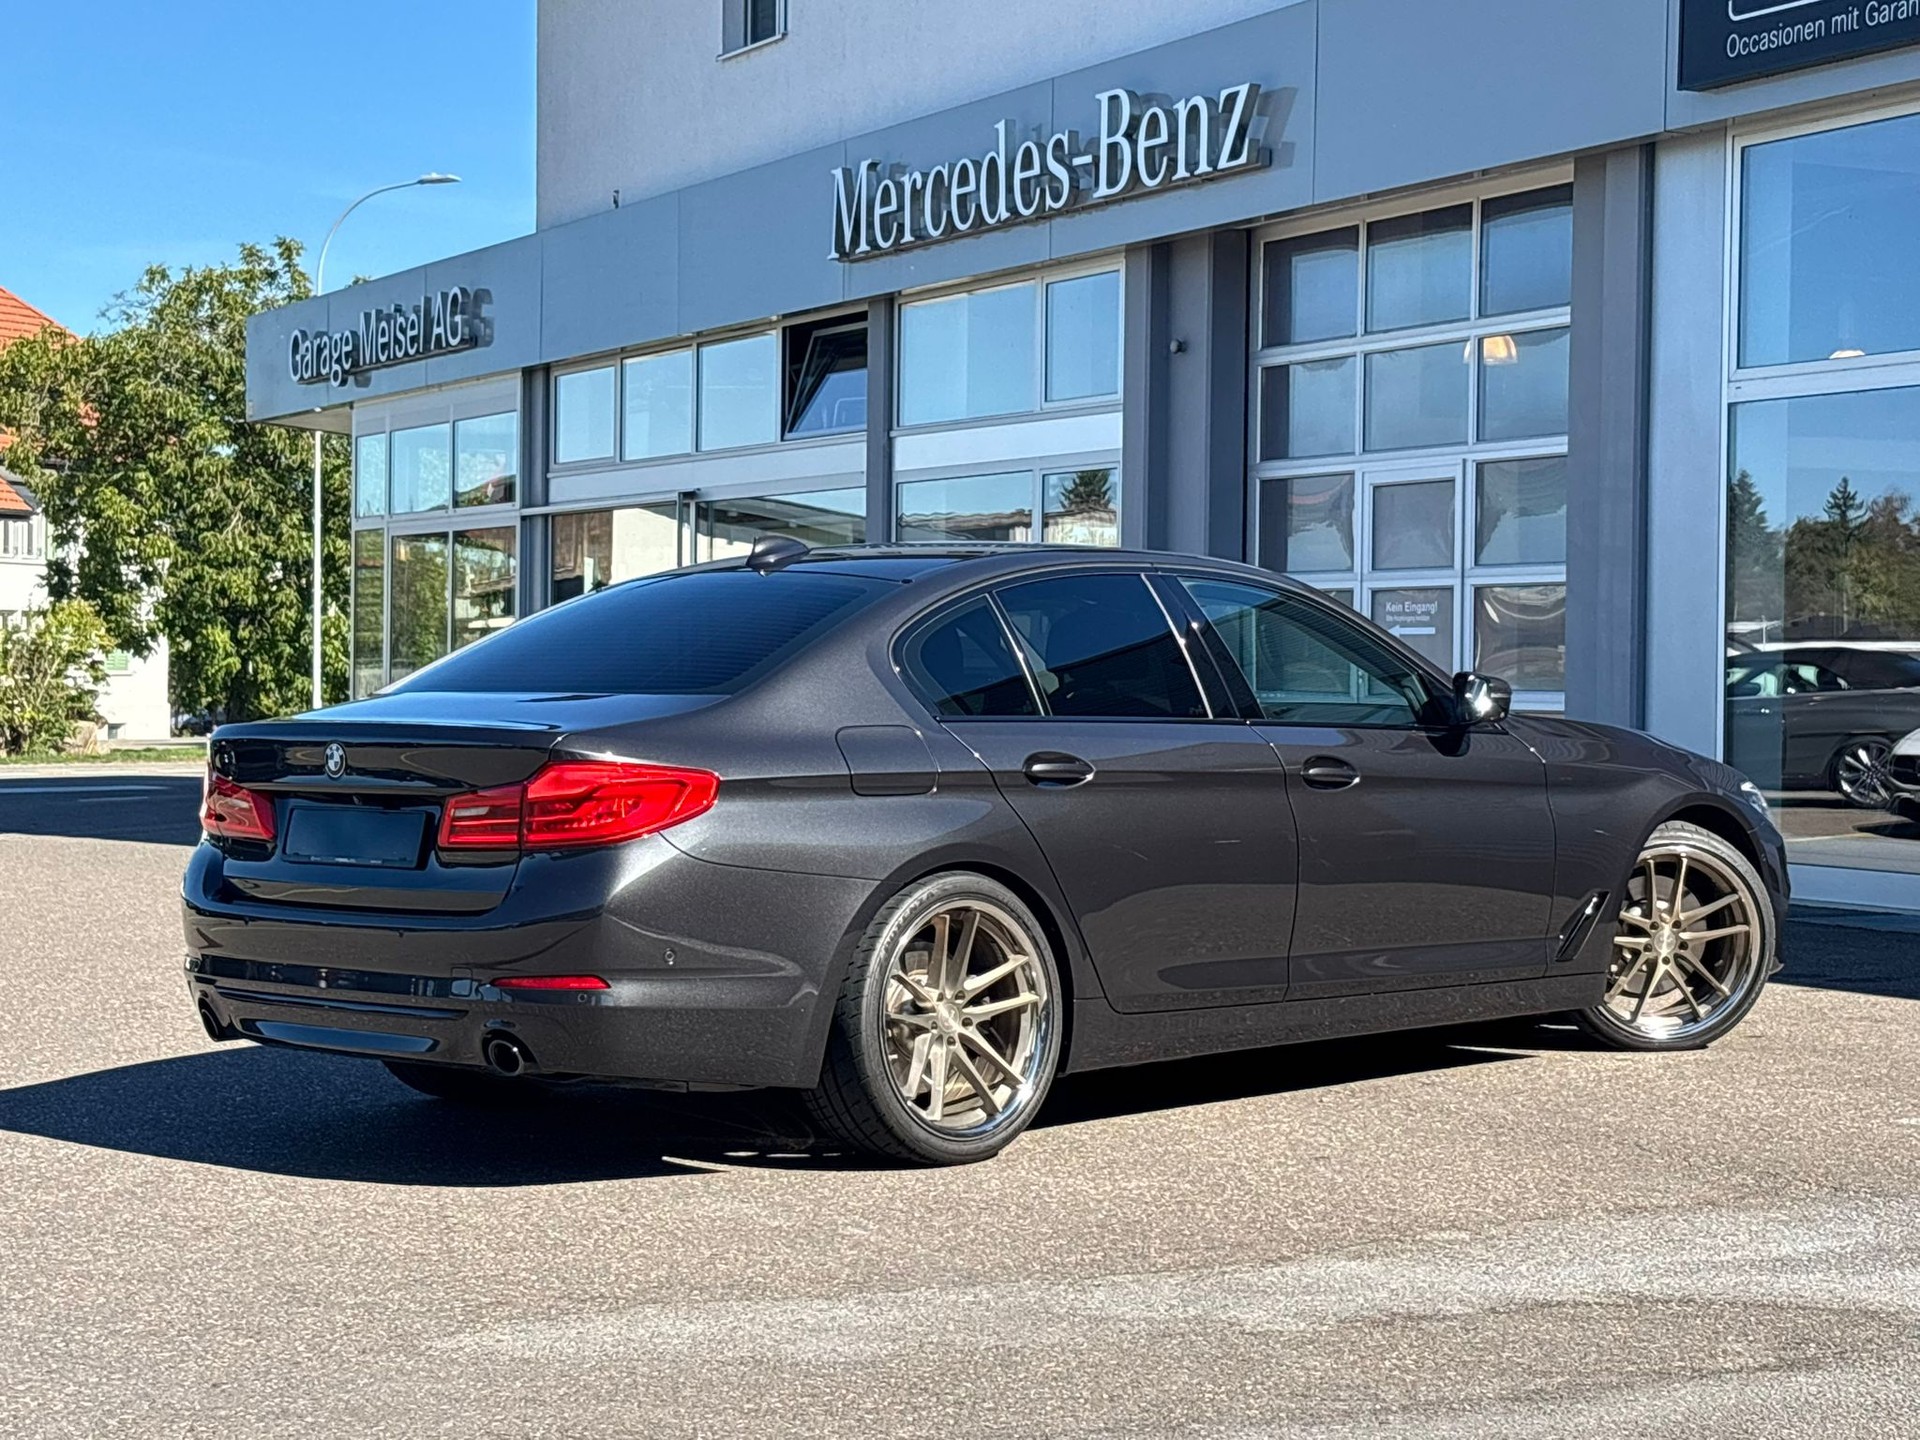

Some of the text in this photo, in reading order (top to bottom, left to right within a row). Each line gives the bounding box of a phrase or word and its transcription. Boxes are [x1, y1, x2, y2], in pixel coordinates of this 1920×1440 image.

[1726, 19, 1826, 58] Occasionen
[1831, 6, 1860, 35] mit
[827, 82, 1254, 261] Mercedes-Benz
[289, 286, 464, 387] Garage Meisel AG
[1385, 601, 1438, 615] Kein Eingang!
